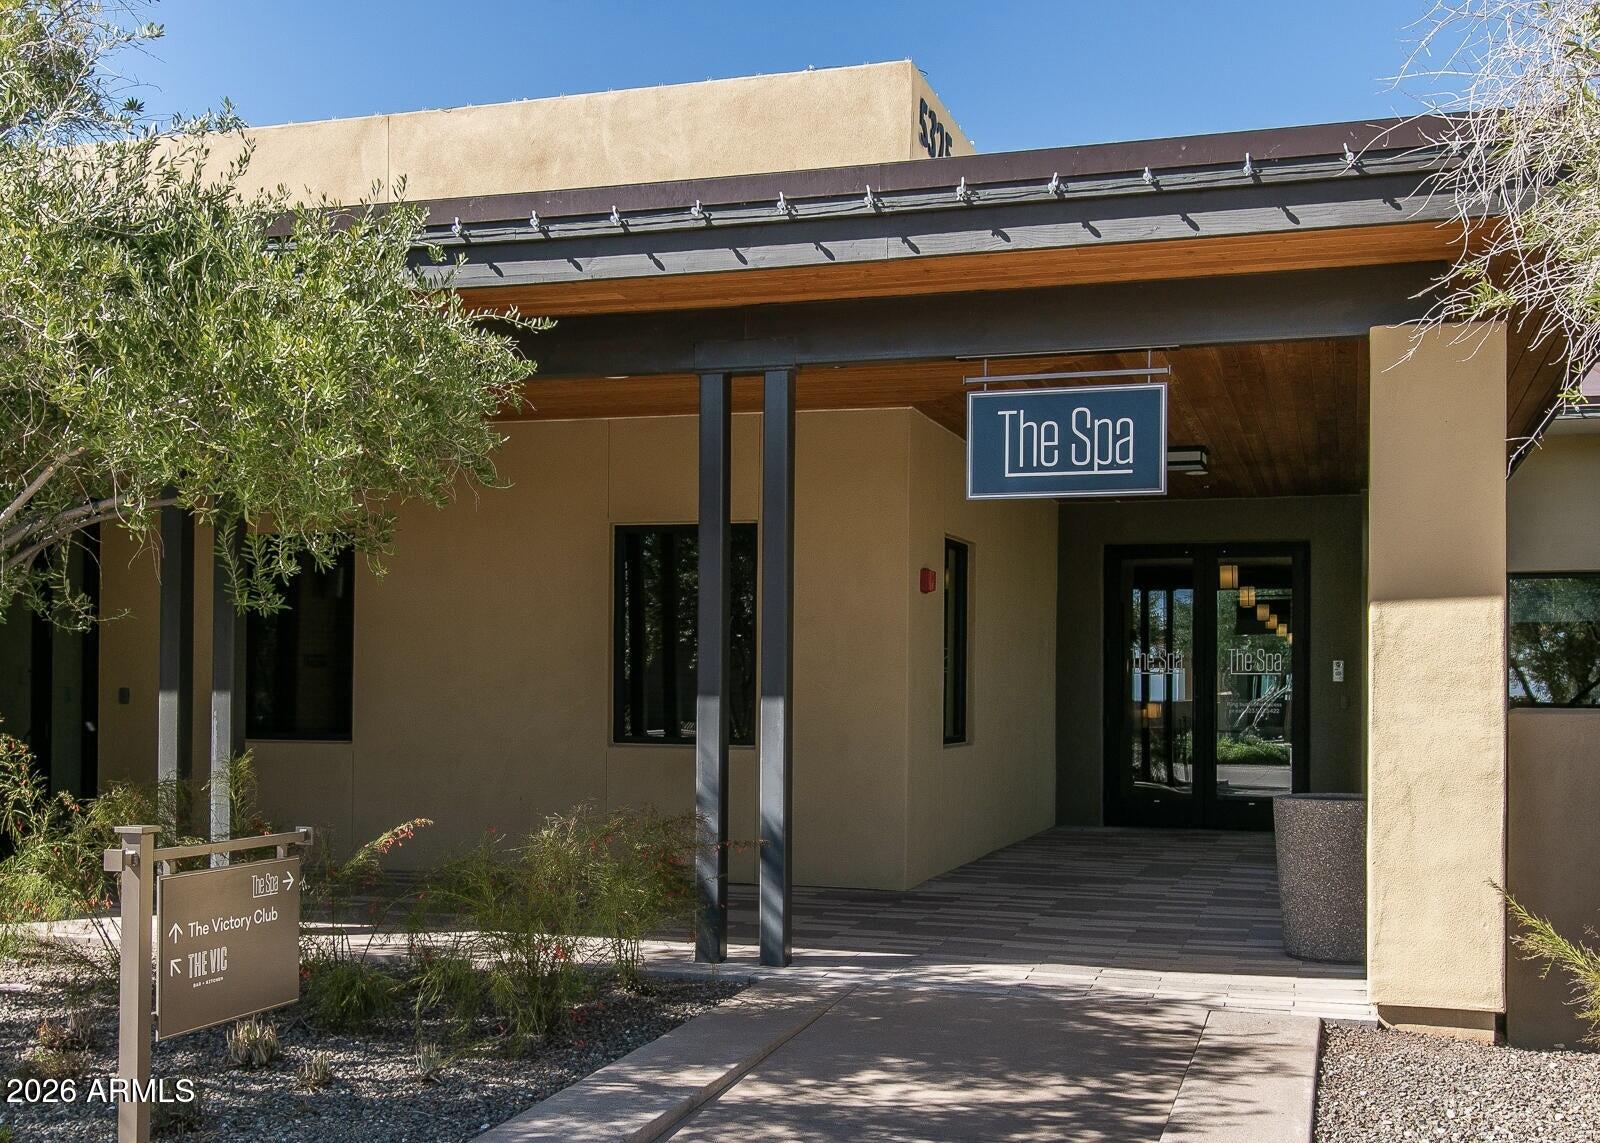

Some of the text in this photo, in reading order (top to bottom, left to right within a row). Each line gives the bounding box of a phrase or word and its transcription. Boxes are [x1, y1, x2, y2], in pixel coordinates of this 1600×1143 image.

[997, 407, 1134, 478] The Spa
[1158, 648, 1183, 674] Spa
[1228, 648, 1282, 675] The Spa
[251, 872, 279, 898] The Spa
[188, 906, 278, 938] The Victory Club
[188, 946, 228, 979] THE VIC
